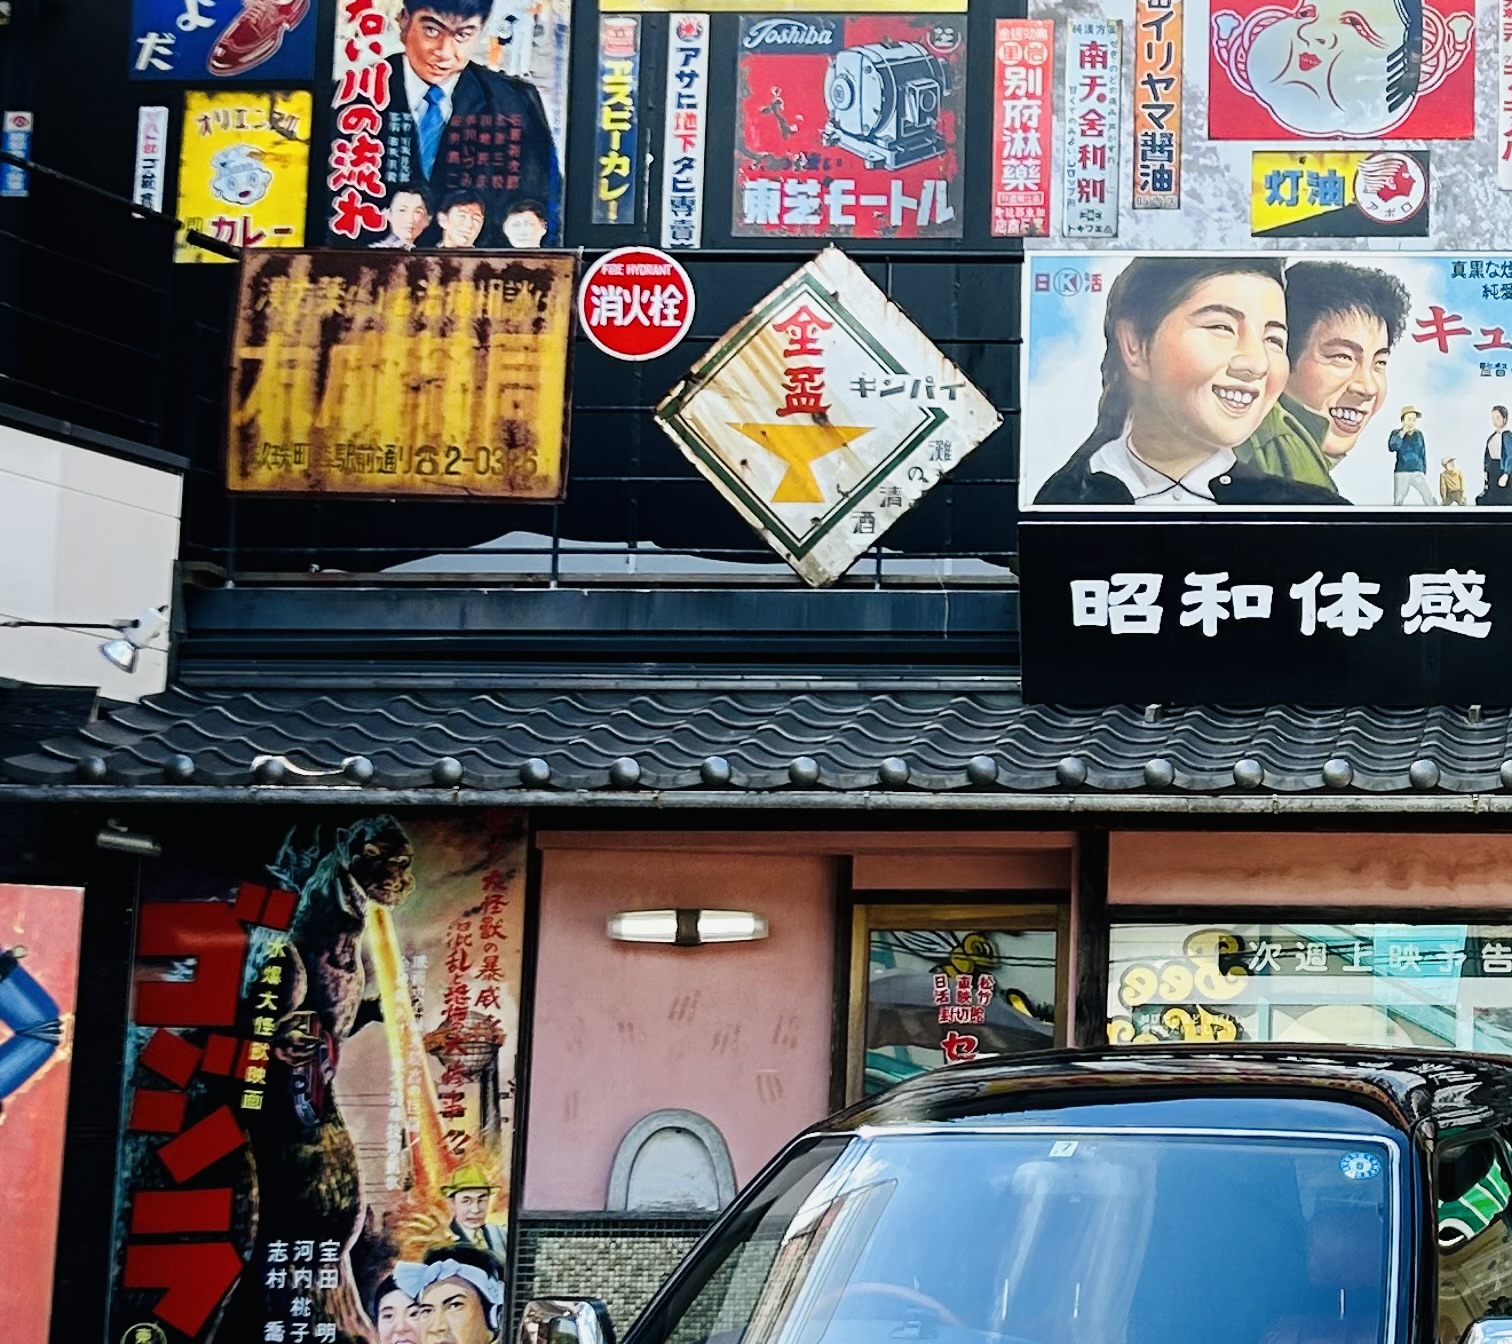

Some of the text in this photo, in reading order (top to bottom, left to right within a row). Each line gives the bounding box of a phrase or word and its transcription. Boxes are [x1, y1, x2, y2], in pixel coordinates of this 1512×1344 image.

[743, 18, 834, 49] Toshiba
[598, 60, 634, 223] エスビーカレー
[743, 179, 955, 226] 東芝モートル
[1264, 169, 1346, 208] 灯油
[1367, 201, 1413, 219] アポロ
[211, 216, 292, 247] カレー
[602, 263, 625, 276] FIRE
[590, 284, 684, 327] 消火栓
[850, 375, 966, 401] キンパイ
[1070, 568, 1493, 639] 昭和体感
[933, 974, 950, 1004] 日活
[123, 881, 299, 1338] ゴジラ
[289, 1240, 315, 1343] 河内桃子
[315, 1239, 342, 1344] 宝田明
